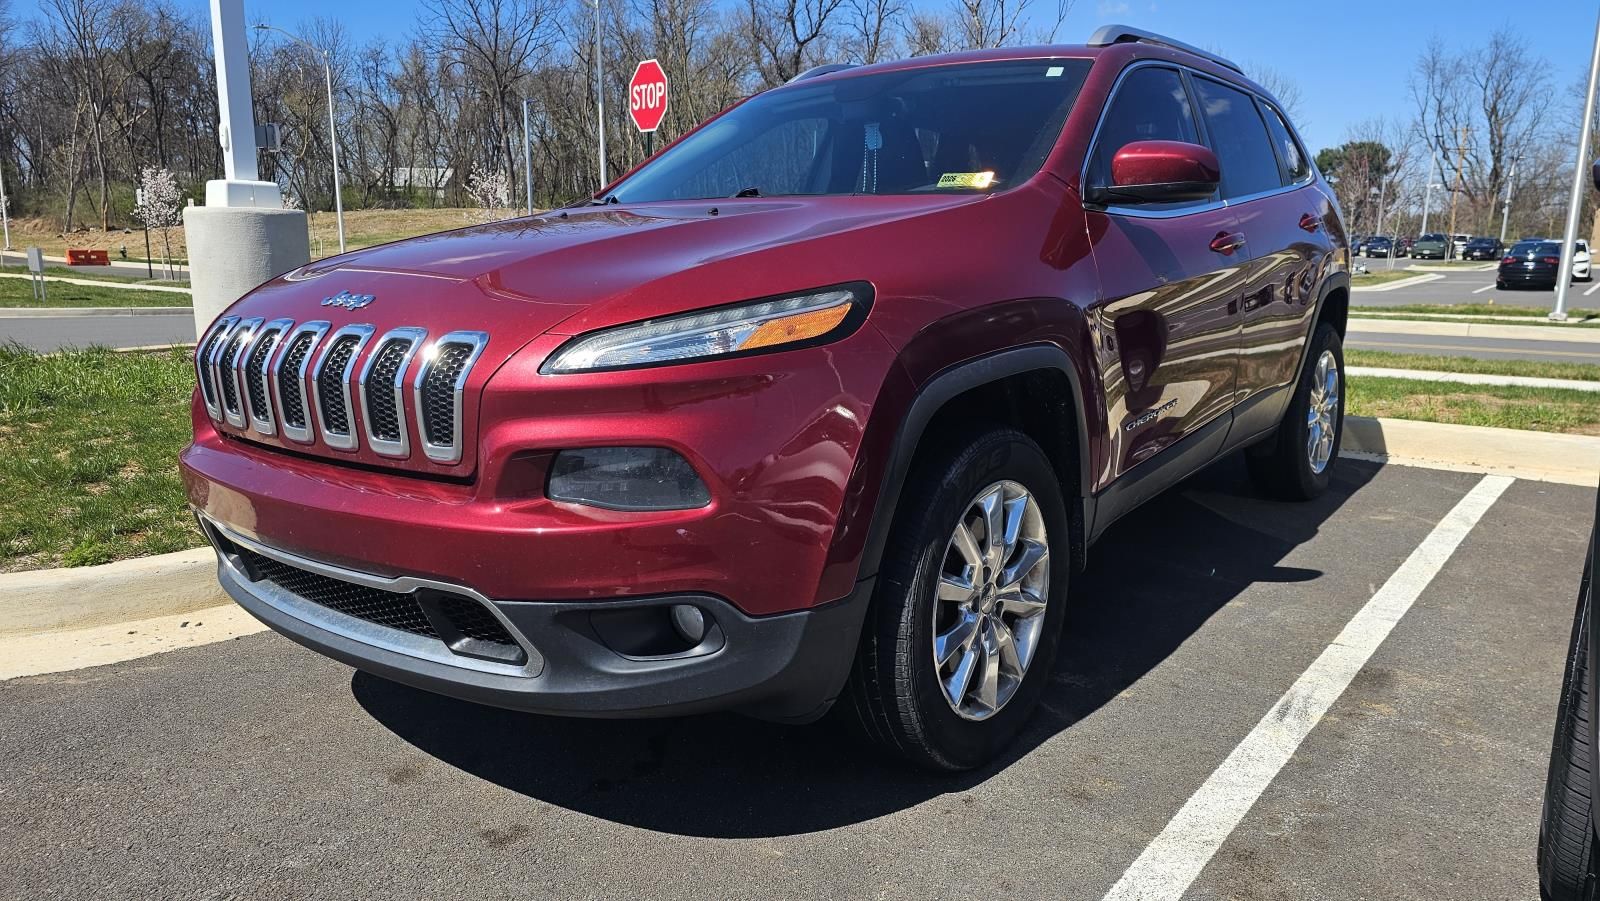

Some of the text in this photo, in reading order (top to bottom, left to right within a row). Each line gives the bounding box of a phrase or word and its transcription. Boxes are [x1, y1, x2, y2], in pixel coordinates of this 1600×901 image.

[632, 82, 665, 111] STOP
[321, 290, 376, 311] Jeep
[1125, 398, 1178, 431] CHEROKEE
